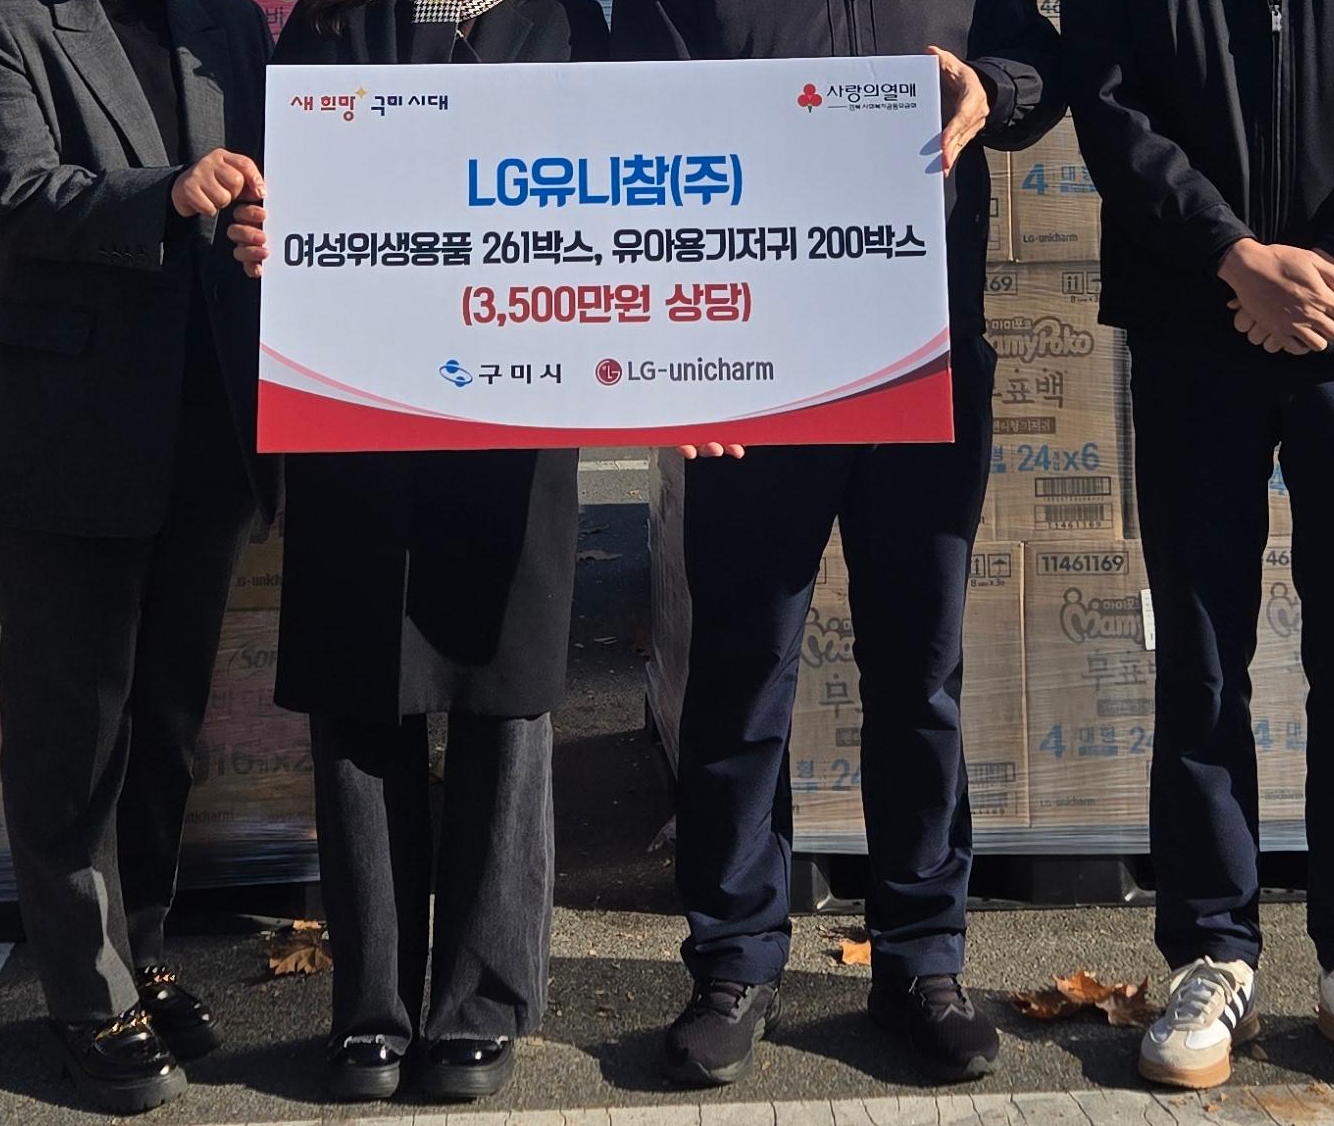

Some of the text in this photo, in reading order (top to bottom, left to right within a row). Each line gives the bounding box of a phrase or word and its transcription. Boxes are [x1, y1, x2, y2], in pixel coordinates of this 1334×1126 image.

[827, 82, 916, 103] 사랑의열매
[291, 94, 449, 121] 새 희망 구미 시대
[467, 153, 744, 210] LG유니참(주)
[283, 224, 927, 268] 여성위생용품 261박스, 유아용기저귀 200박스
[1022, 233, 1079, 244] LG-unicharm
[461, 282, 753, 328] (3,500만원 상당)
[989, 316, 1095, 363] amyPoko
[478, 362, 563, 386] 구미시
[626, 357, 775, 383] LG-unicharm
[1041, 555, 1125, 573] 11461169
[1039, 724, 1066, 759] 4
